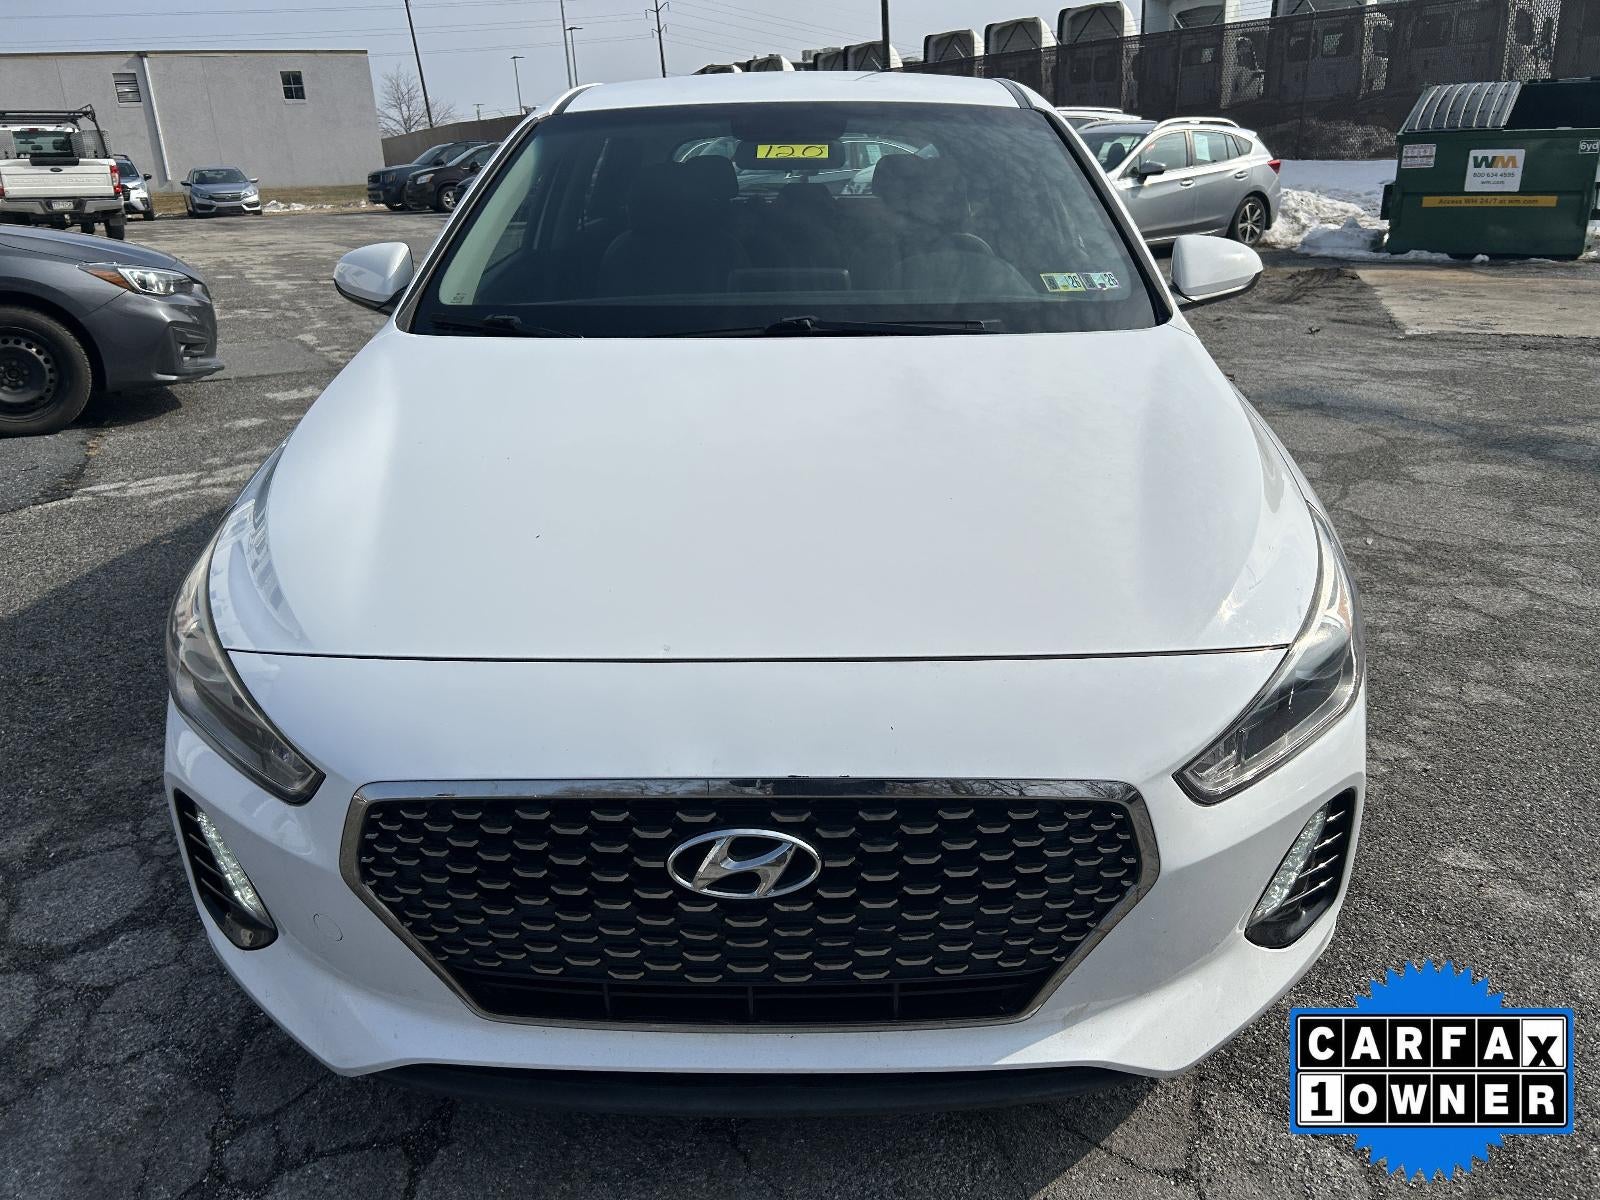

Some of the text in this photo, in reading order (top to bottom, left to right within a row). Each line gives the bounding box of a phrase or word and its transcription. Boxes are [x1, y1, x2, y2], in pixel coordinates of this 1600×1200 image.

[764, 145, 825, 158] 120
[1580, 141, 1599, 151] 6yd
[1472, 155, 1519, 169] WM
